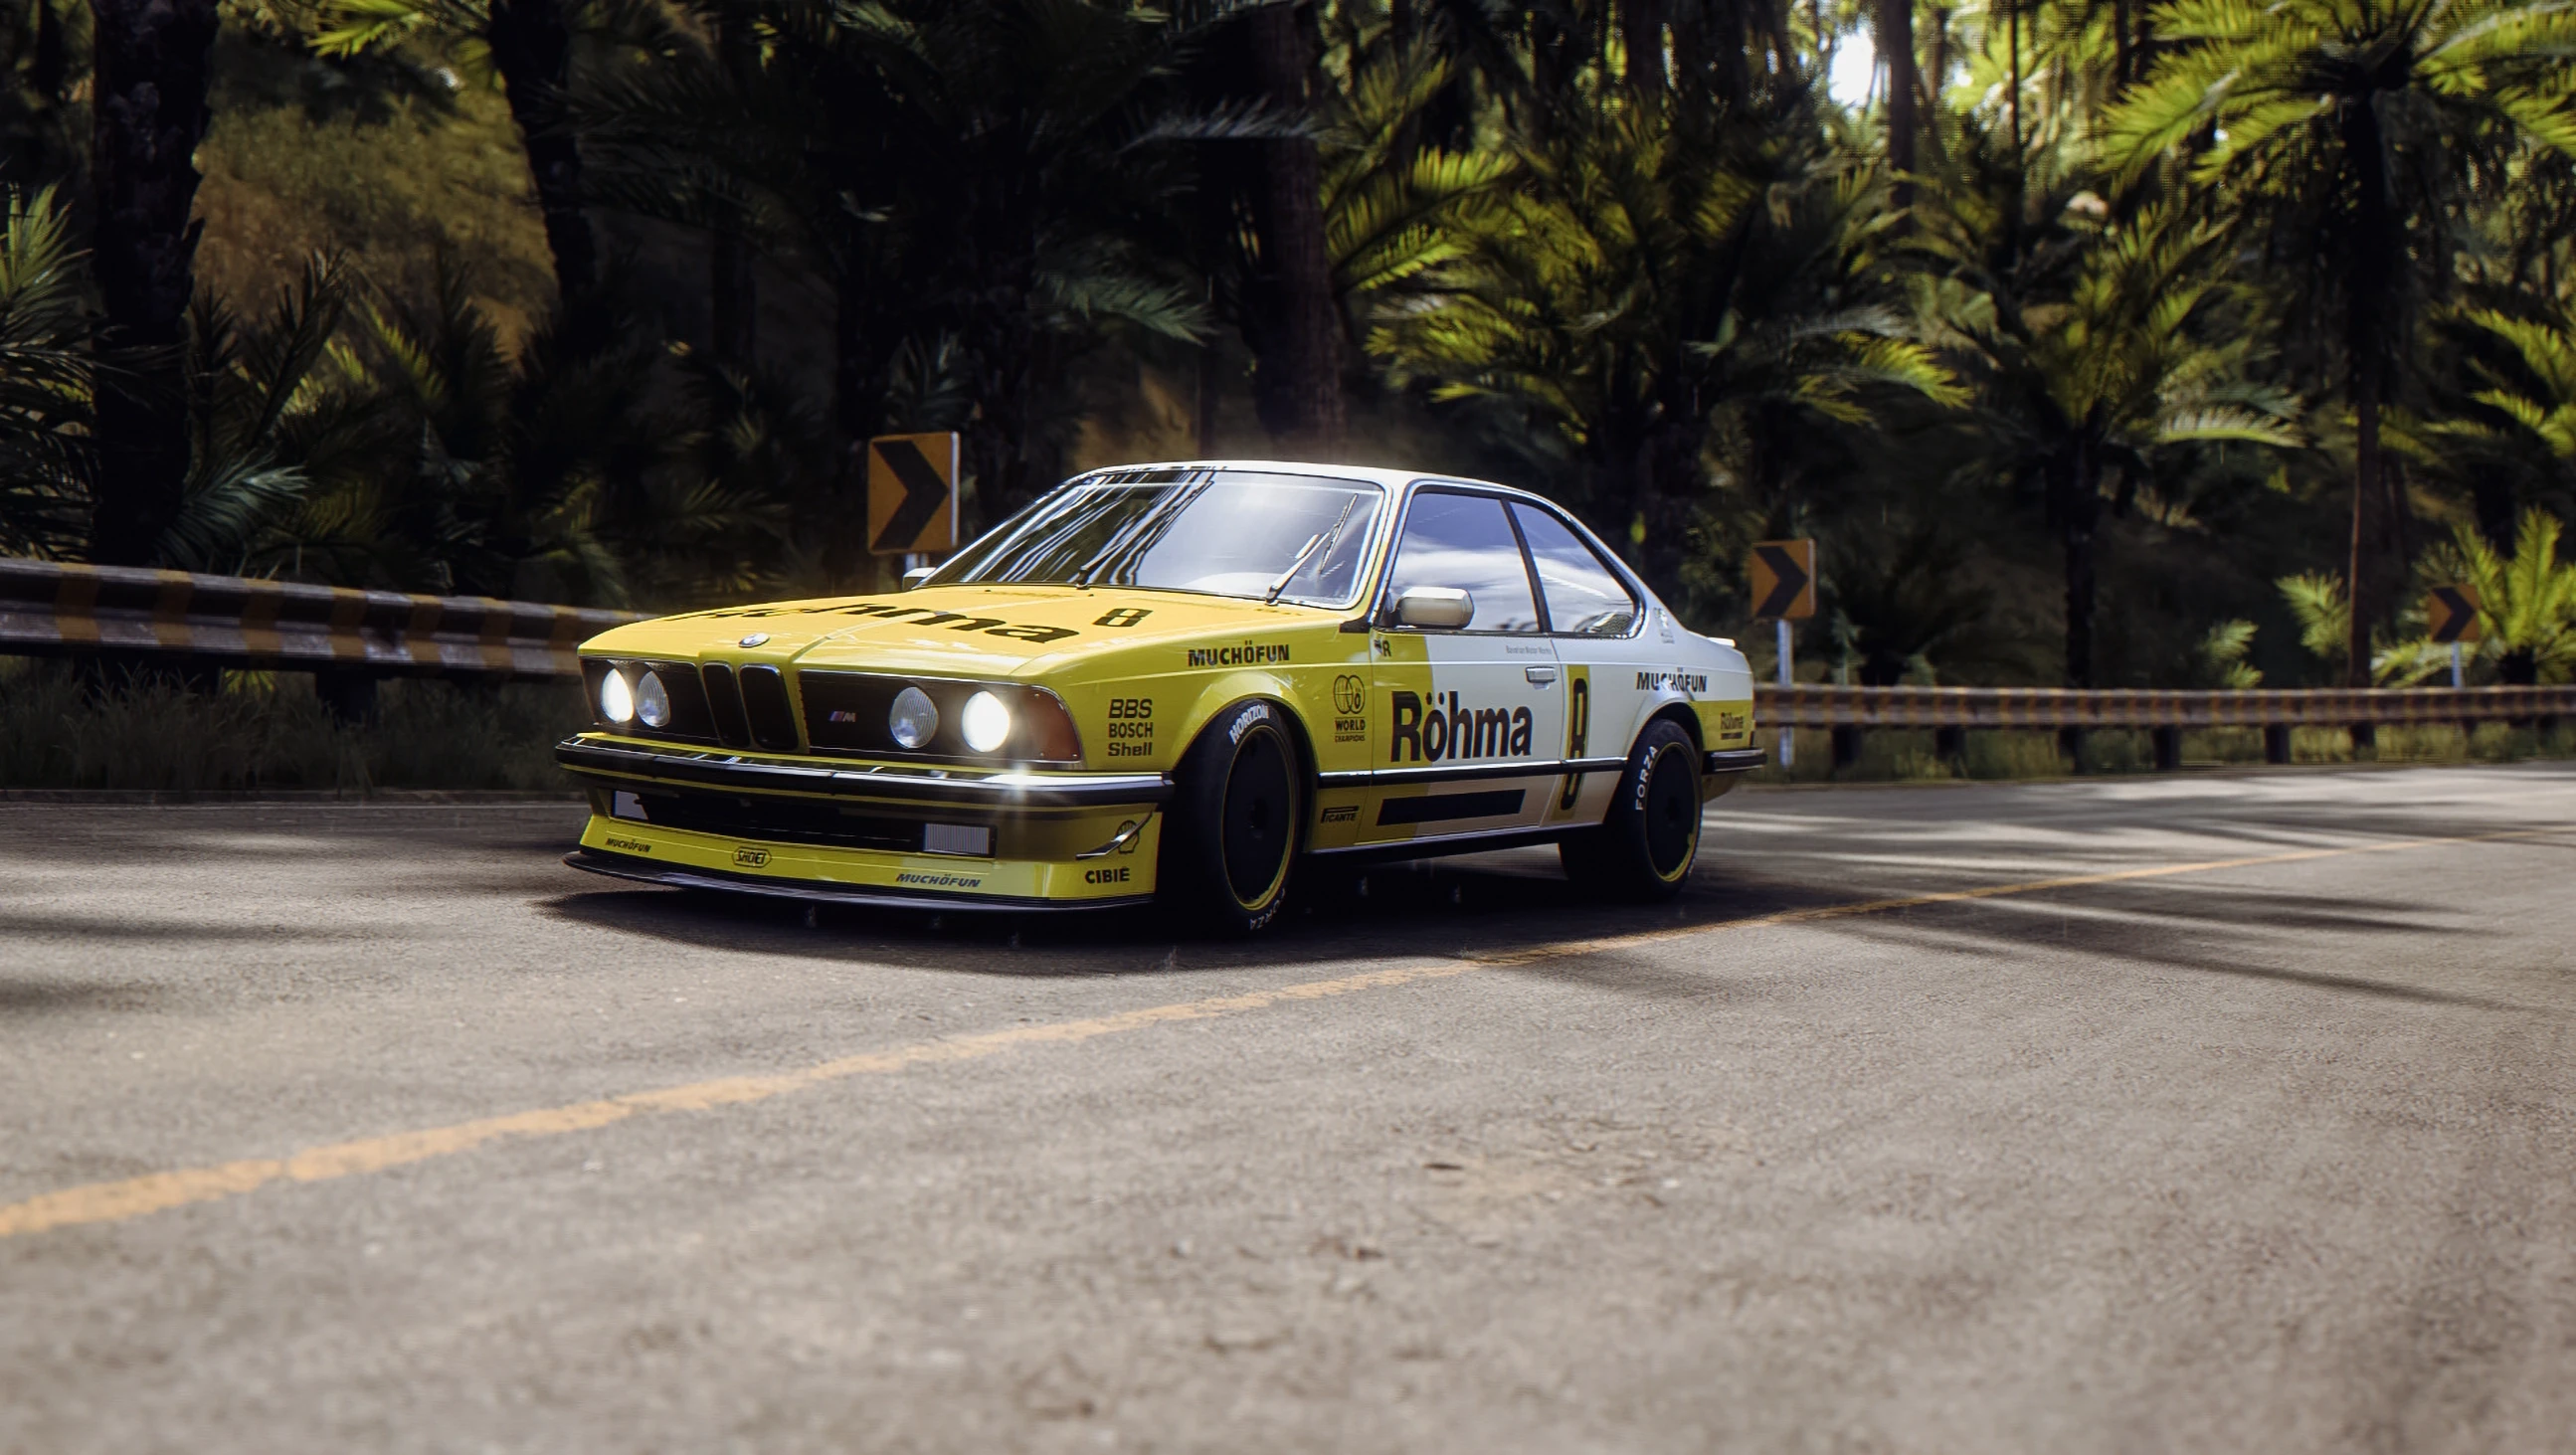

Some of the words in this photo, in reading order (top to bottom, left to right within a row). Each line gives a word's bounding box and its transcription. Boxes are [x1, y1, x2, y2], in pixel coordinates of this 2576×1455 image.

[1092, 608, 1154, 628] 8
[1188, 639, 1290, 667] MUCHÖFUN
[1108, 698, 1154, 719] BBS
[1108, 722, 1154, 738] BOSCH
[1228, 704, 1270, 745] HORIZON
[1335, 719, 1366, 732] WORLD
[1390, 690, 1534, 763] Röhma
[1108, 742, 1153, 757] Shell
[1560, 677, 1588, 812] 8
[1635, 745, 1660, 811] FORZA
[605, 837, 651, 853] MUCHÖFUN
[736, 849, 768, 865] SHOEI
[895, 872, 983, 888] MUCHÖFUN
